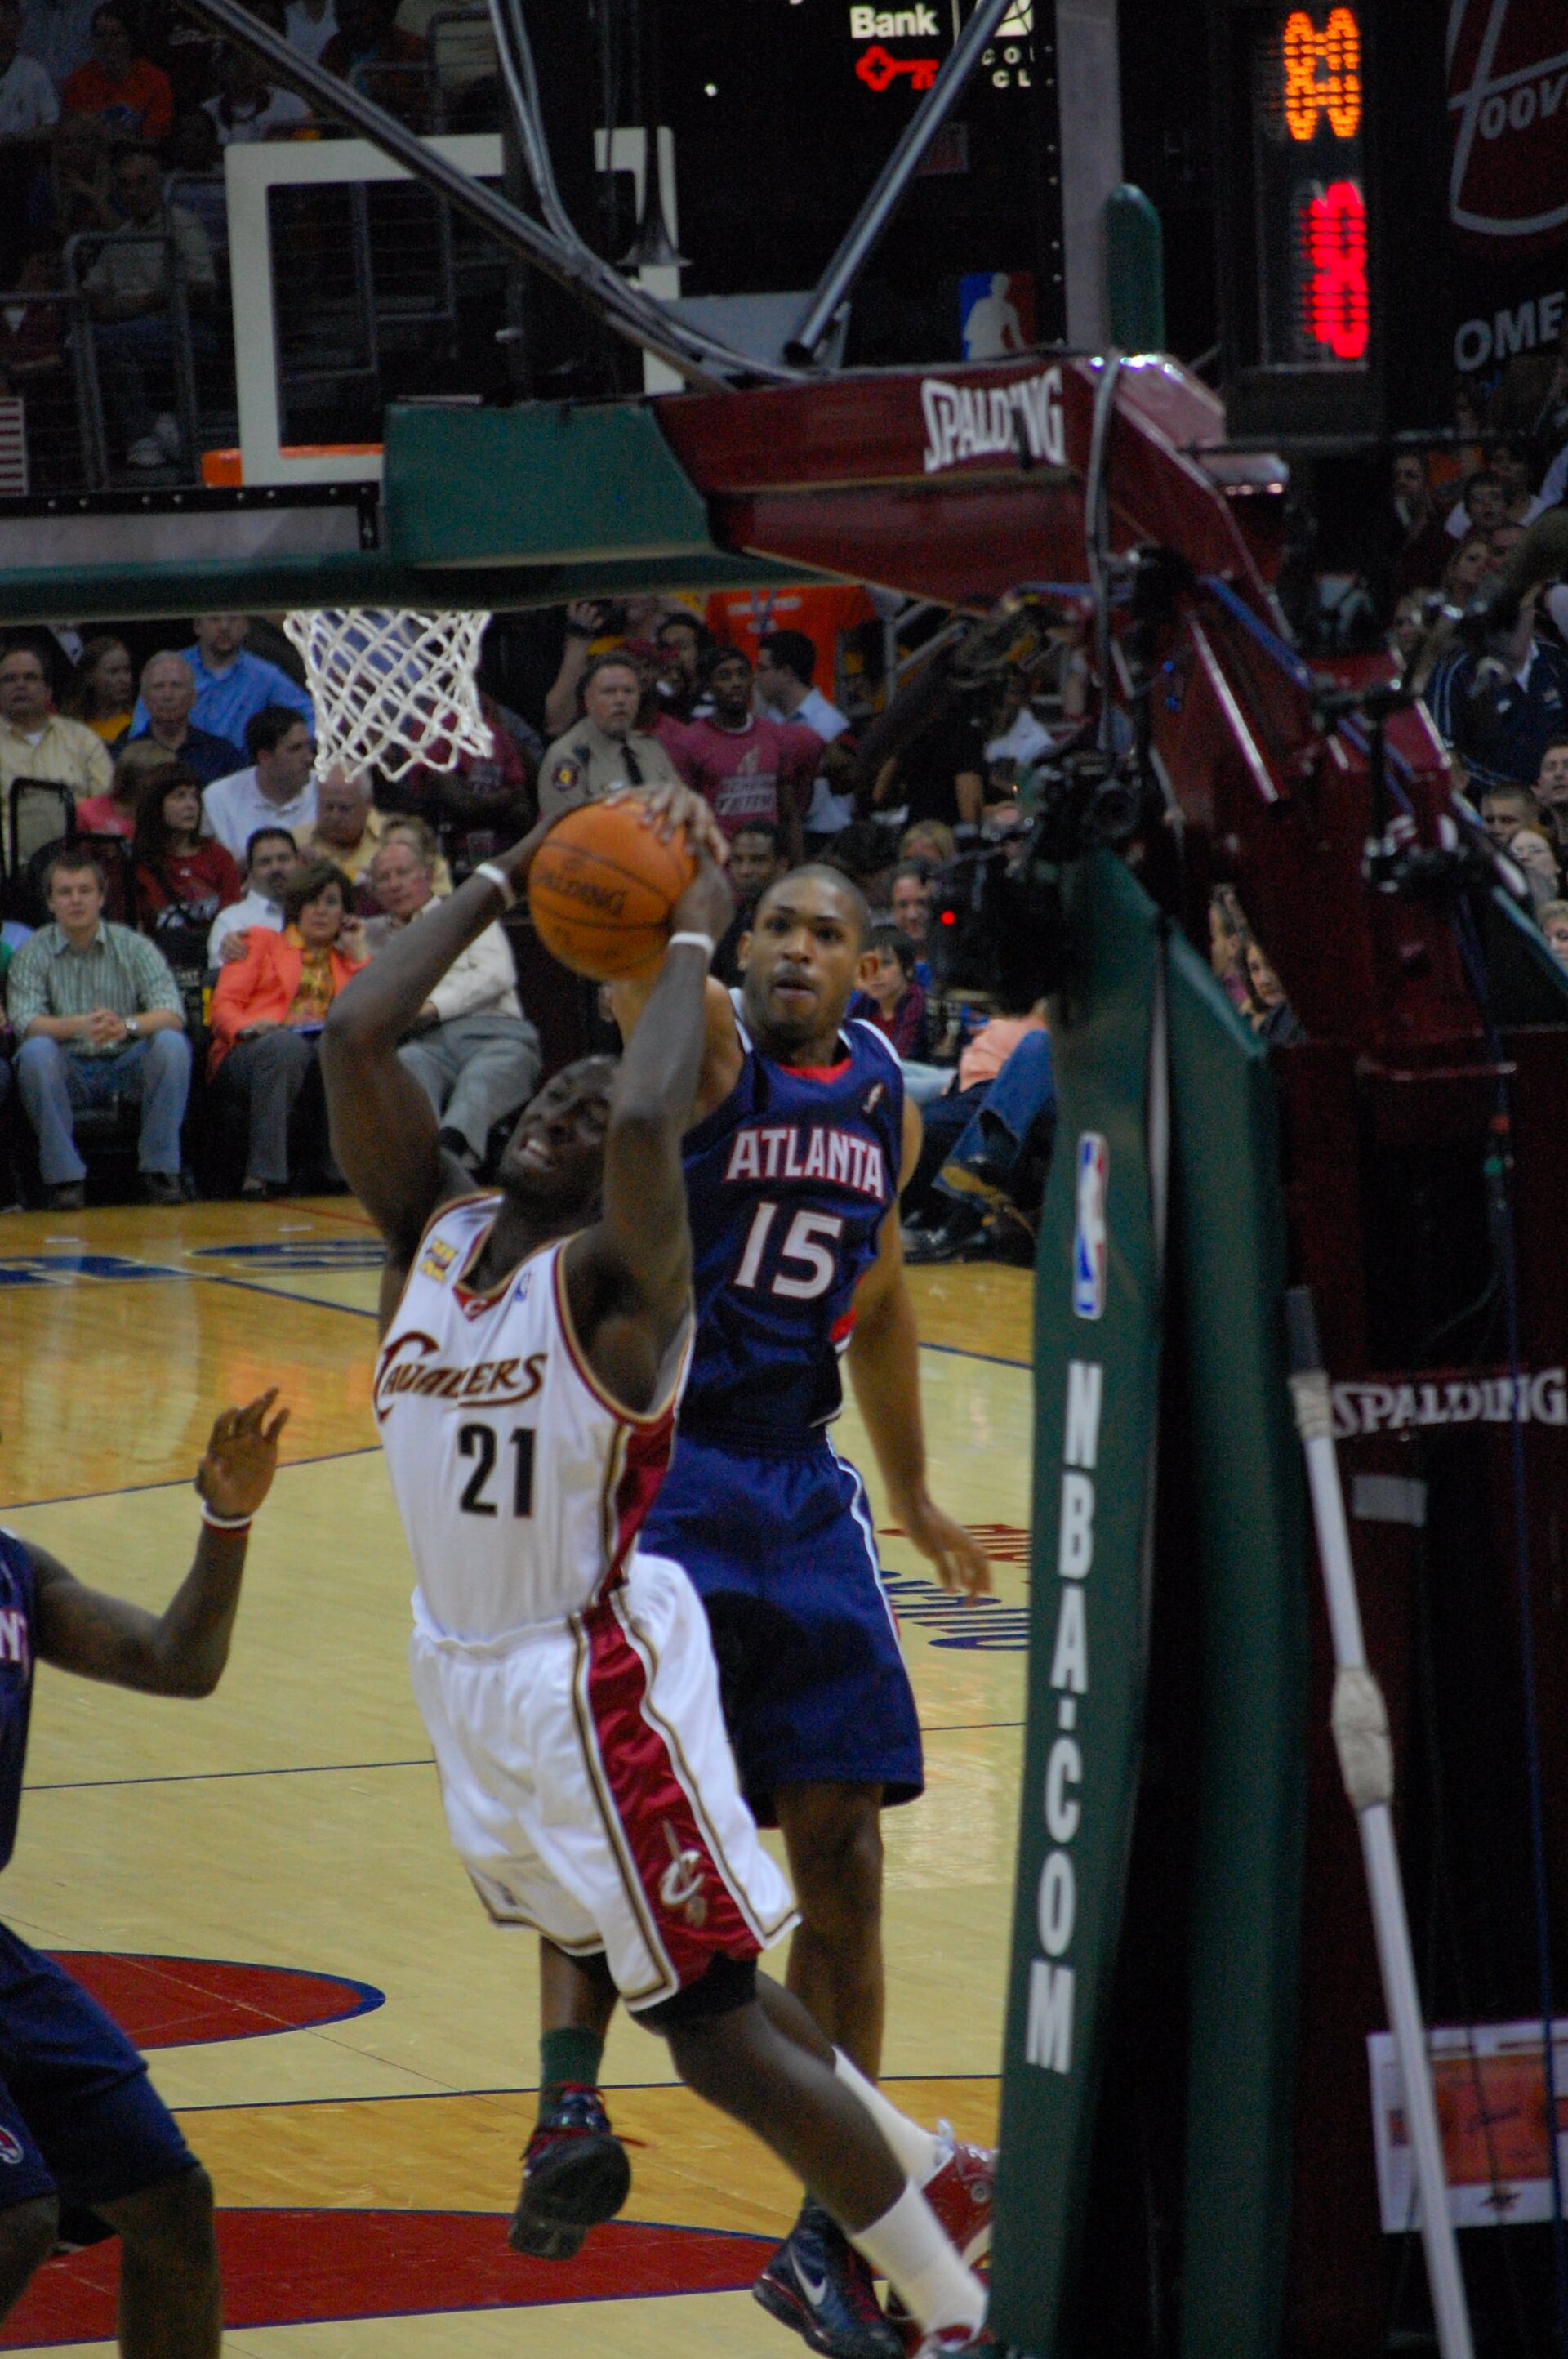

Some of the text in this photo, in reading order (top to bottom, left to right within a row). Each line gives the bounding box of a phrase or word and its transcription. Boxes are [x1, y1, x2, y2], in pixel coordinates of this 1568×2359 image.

[849, 2, 941, 39] Bank
[724, 1125, 885, 1202] ATLANTA
[733, 1200, 844, 1300] 15
[459, 1422, 536, 1519] 21
